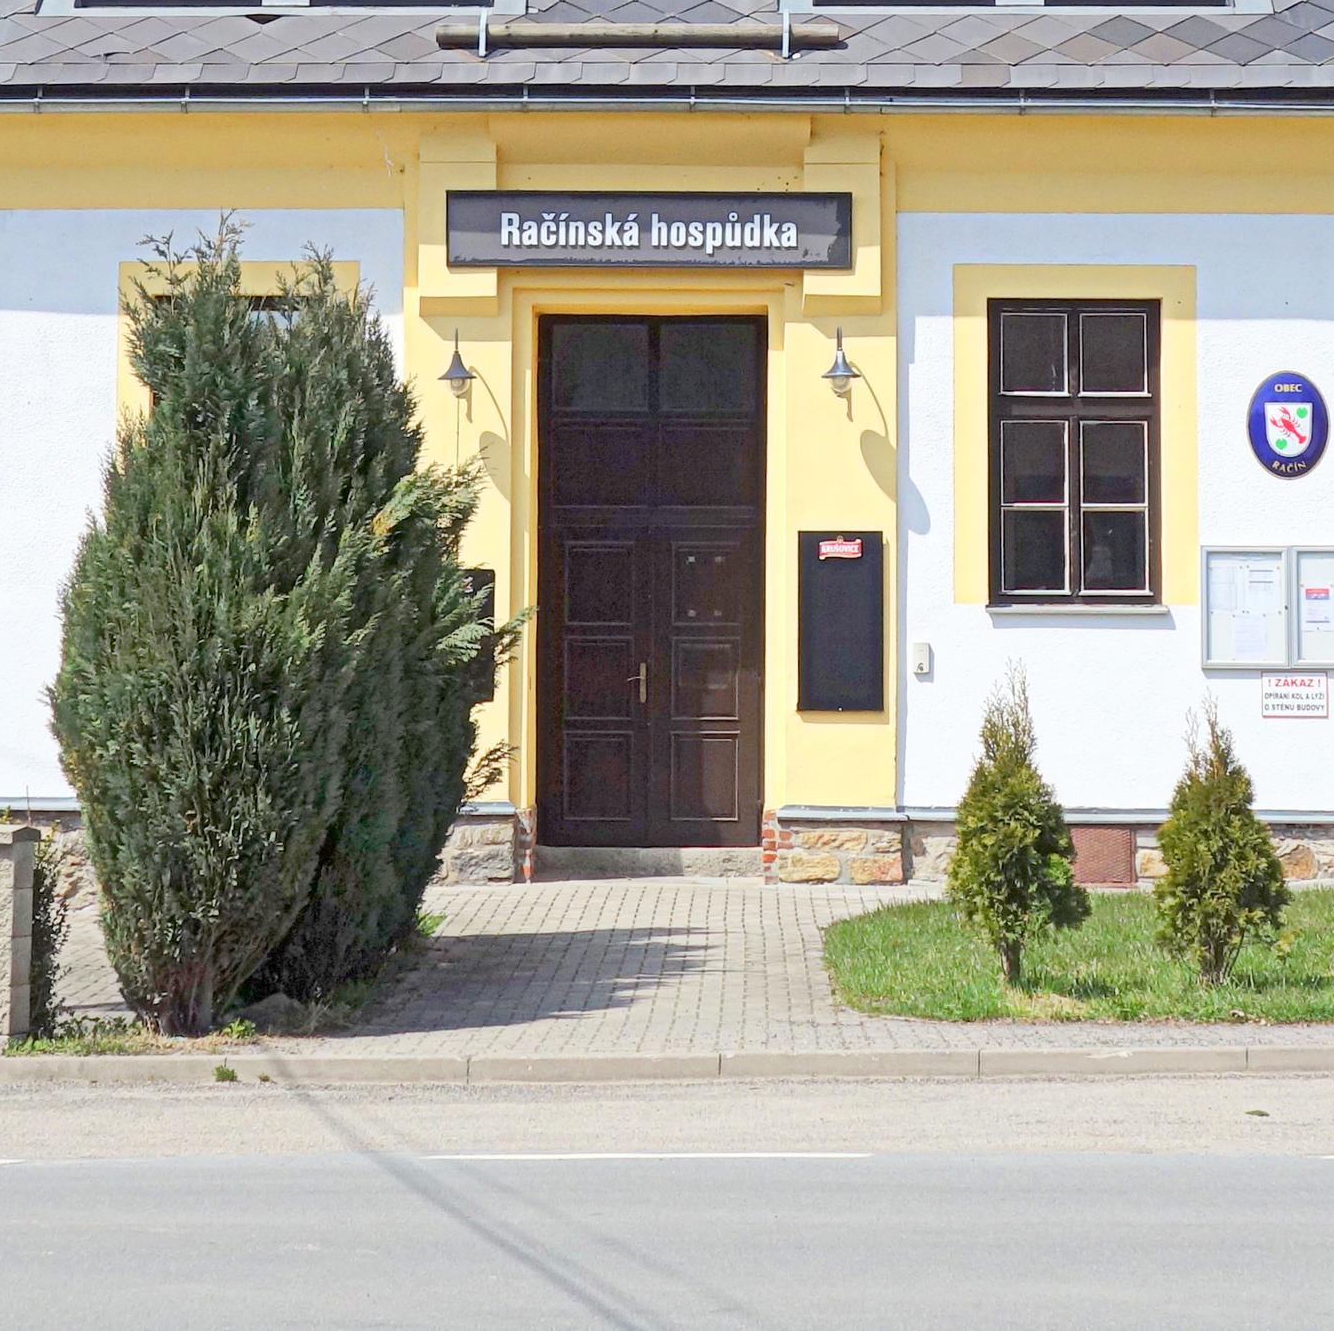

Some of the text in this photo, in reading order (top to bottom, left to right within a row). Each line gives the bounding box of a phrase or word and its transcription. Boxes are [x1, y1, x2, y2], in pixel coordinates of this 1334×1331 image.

[500, 212, 798, 256] Račínská hospůdka
[1274, 383, 1303, 393] OBEC
[1272, 459, 1307, 473] RAČÍN
